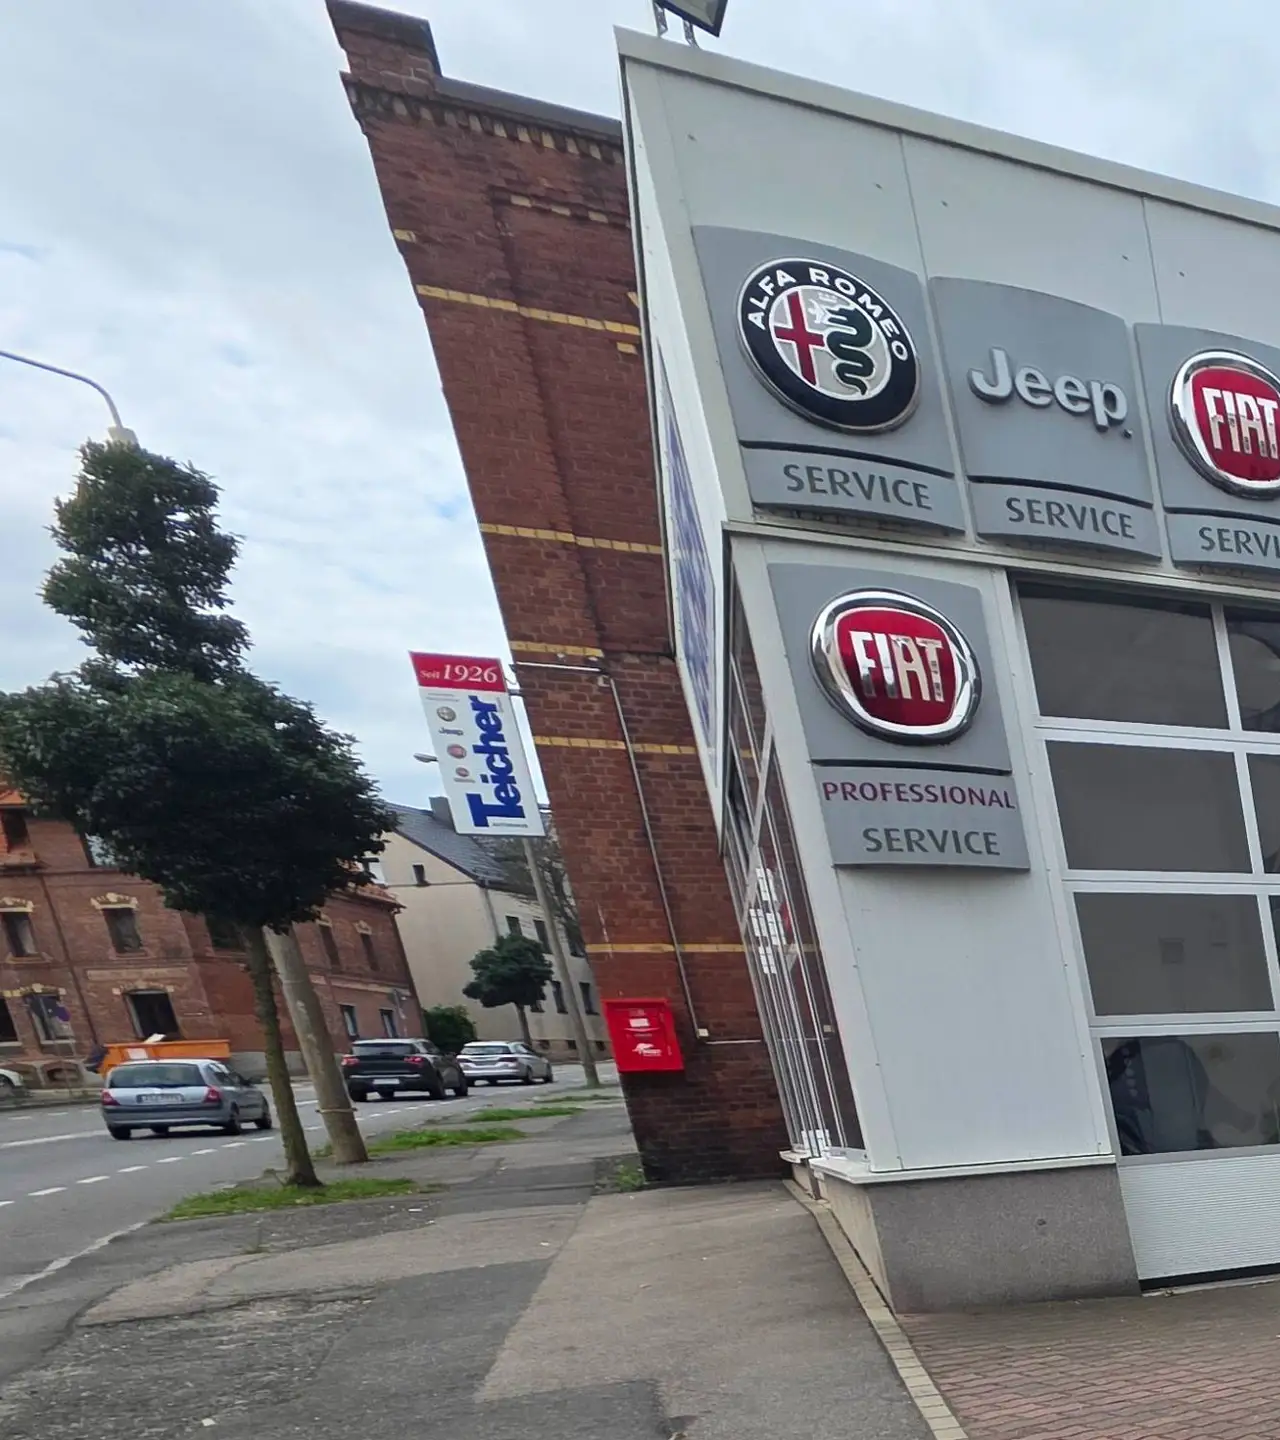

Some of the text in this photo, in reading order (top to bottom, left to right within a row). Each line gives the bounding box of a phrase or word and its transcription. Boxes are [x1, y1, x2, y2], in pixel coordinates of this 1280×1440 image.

[747, 266, 908, 362] ALFA ROMEO
[966, 348, 1129, 428] Jeep
[783, 463, 932, 511] SERVICE
[1006, 497, 1136, 540] SERVICE
[443, 664, 498, 683] 1926
[850, 629, 945, 702] FIAT
[466, 695, 526, 827] Teicher
[822, 780, 1015, 810] PROFESSIONAL
[862, 827, 1001, 857] SERVICE
